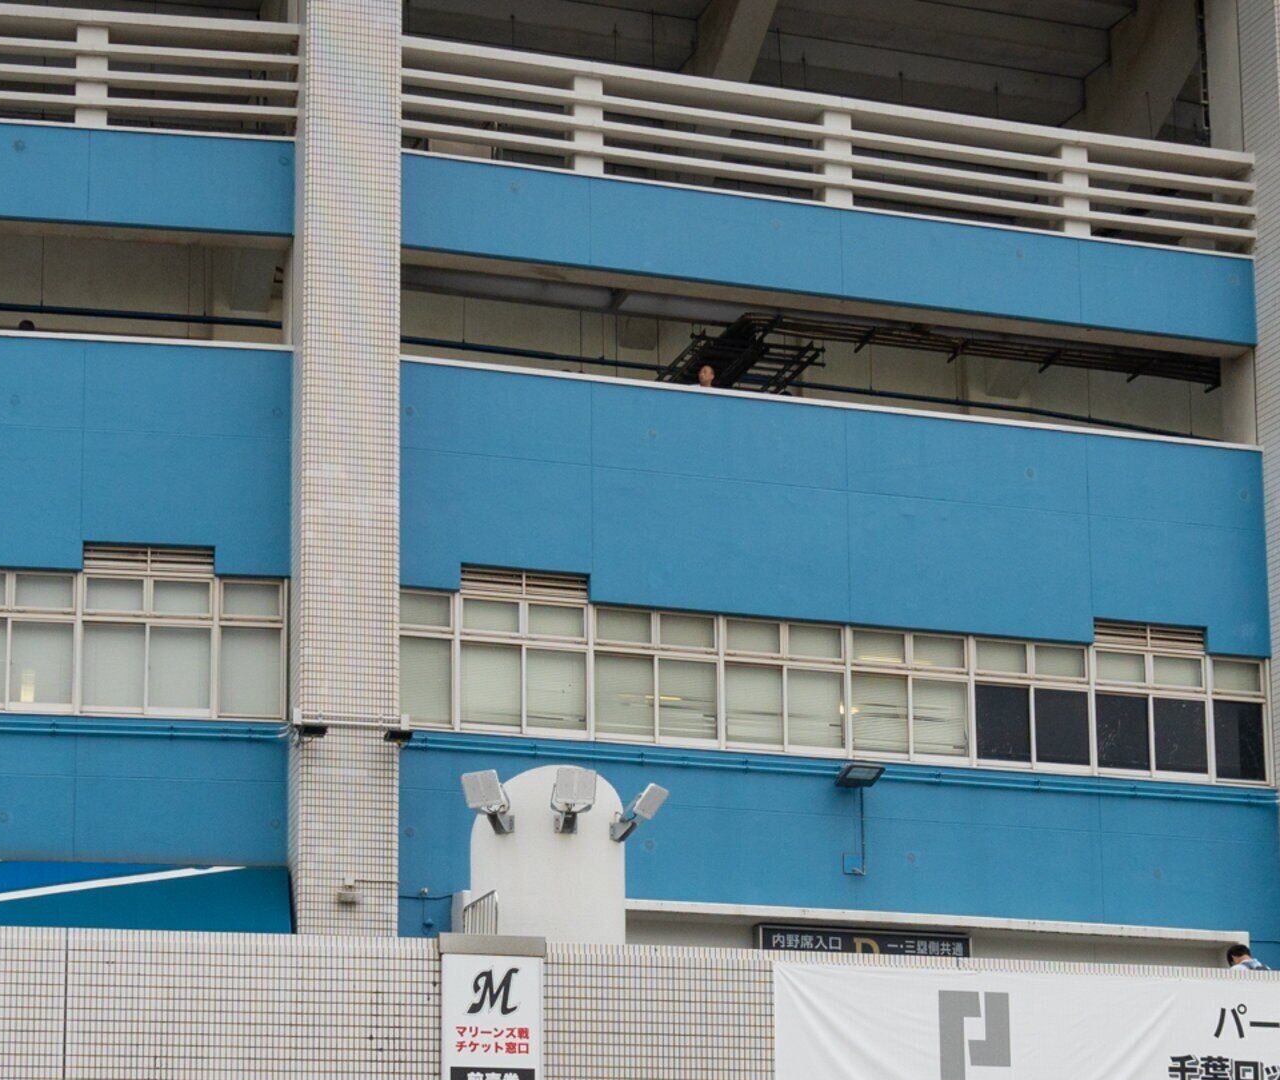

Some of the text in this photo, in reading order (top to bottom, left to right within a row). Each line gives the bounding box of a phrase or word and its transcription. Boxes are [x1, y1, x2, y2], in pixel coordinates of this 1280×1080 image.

[772, 934, 842, 950] 内野席入口
[455, 1026, 530, 1040] マリーンズ戦
[455, 1041, 530, 1055] チケット窓口
